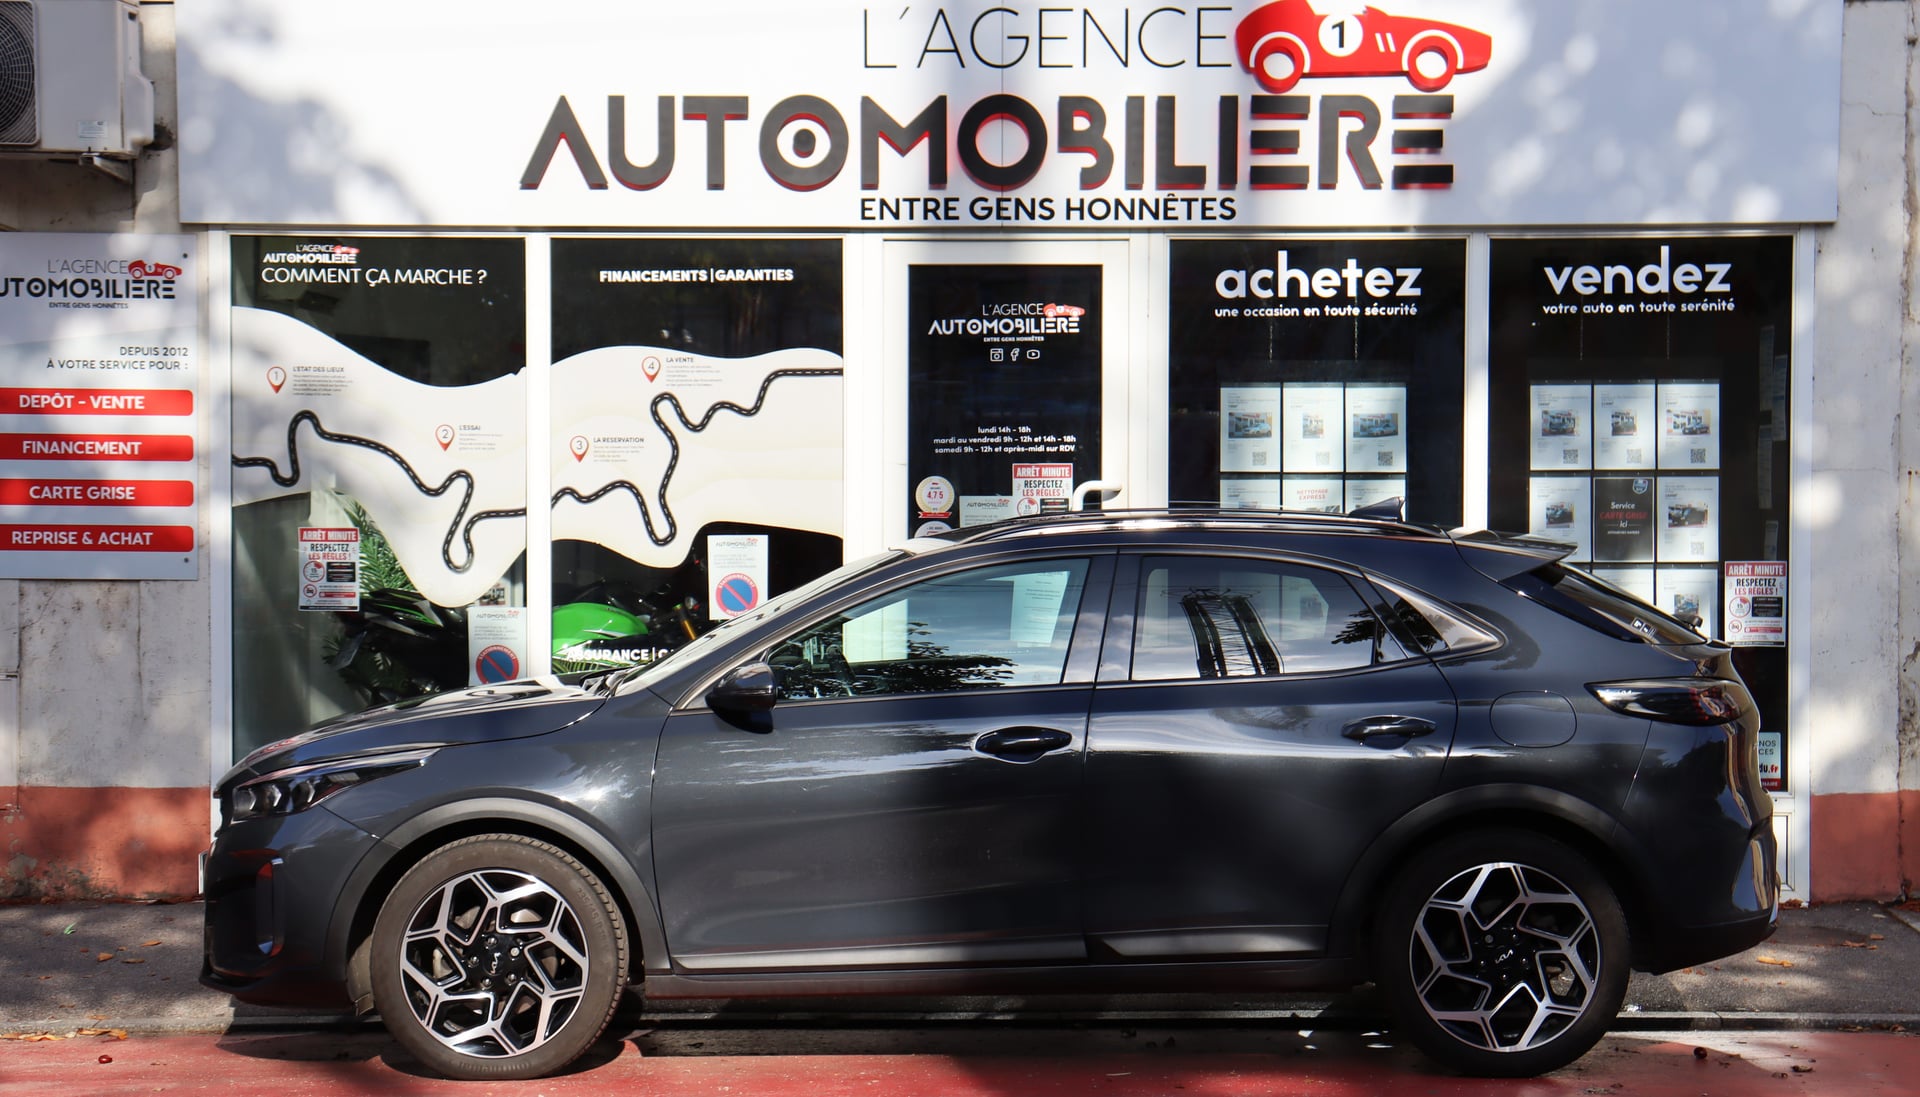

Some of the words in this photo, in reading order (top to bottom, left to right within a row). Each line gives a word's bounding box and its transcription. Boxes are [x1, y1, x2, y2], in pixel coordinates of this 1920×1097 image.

[863, 6, 1232, 69] L'AGENCE
[1330, 19, 1347, 49] 1
[519, 94, 1456, 192] AUTOMOBILIERE
[860, 197, 960, 221] ENTRE
[968, 197, 1056, 221] GENS
[1066, 193, 1237, 221] HONNÊTES
[47, 259, 128, 274] L'AGENCE
[1544, 245, 1732, 295] vendez
[261, 267, 361, 284] COMMENT
[365, 269, 391, 287] ÇA
[394, 269, 473, 284] MARCHE
[477, 269, 488, 284] ?
[600, 270, 708, 283] FINANCEMENTS
[1215, 250, 1422, 299] achetez
[0, 277, 176, 299] UTOMOBILIERE
[982, 303, 1044, 316] L'AGENCE
[1215, 307, 1239, 318] une
[1243, 305, 1299, 317] occasion
[1303, 307, 1320, 317] en
[1324, 304, 1360, 317] toute
[1364, 302, 1418, 316] sécurité
[1543, 302, 1577, 314] votre
[1582, 302, 1613, 314] auto
[1618, 304, 1634, 313] en
[1639, 301, 1676, 313] toute
[928, 317, 1080, 335] AUTOMOBILIERE
[119, 346, 160, 356] DEPUIS
[162, 346, 189, 357] 2012
[47, 357, 54, 368] À
[58, 359, 96, 369] VOTRE
[99, 359, 145, 370] SERVICE
[149, 360, 181, 371] POUR
[19, 392, 74, 409] DEPÔT
[89, 395, 145, 410] VENTE
[441, 428, 449, 439] 2
[977, 426, 997, 434] lundi
[22, 440, 142, 455] FINANCEMENT
[576, 440, 583, 450] 3
[933, 437, 956, 445] mardi
[935, 446, 962, 454] samedi
[980, 445, 993, 453] 12h
[1003, 444, 1045, 454] après-midi
[1059, 444, 1076, 452] RDV
[1017, 466, 1040, 477] ARRÊT
[1042, 467, 1070, 477] MINUTE
[1024, 480, 1063, 488] RESPECTEZ
[29, 486, 83, 500] CARTE
[87, 486, 136, 500] GRISE
[1022, 489, 1034, 497] LES
[11, 531, 78, 546] REPRISE
[81, 532, 93, 545] &
[98, 531, 153, 546] ACHAT
[310, 543, 350, 552] RESPECTEZ
[1728, 563, 1752, 576] ARRÊT
[1754, 565, 1784, 575] MINUTE
[1736, 578, 1777, 587] RESPECTEZ
[1735, 587, 1747, 595] LES
[1759, 763, 1779, 773] du.fr
